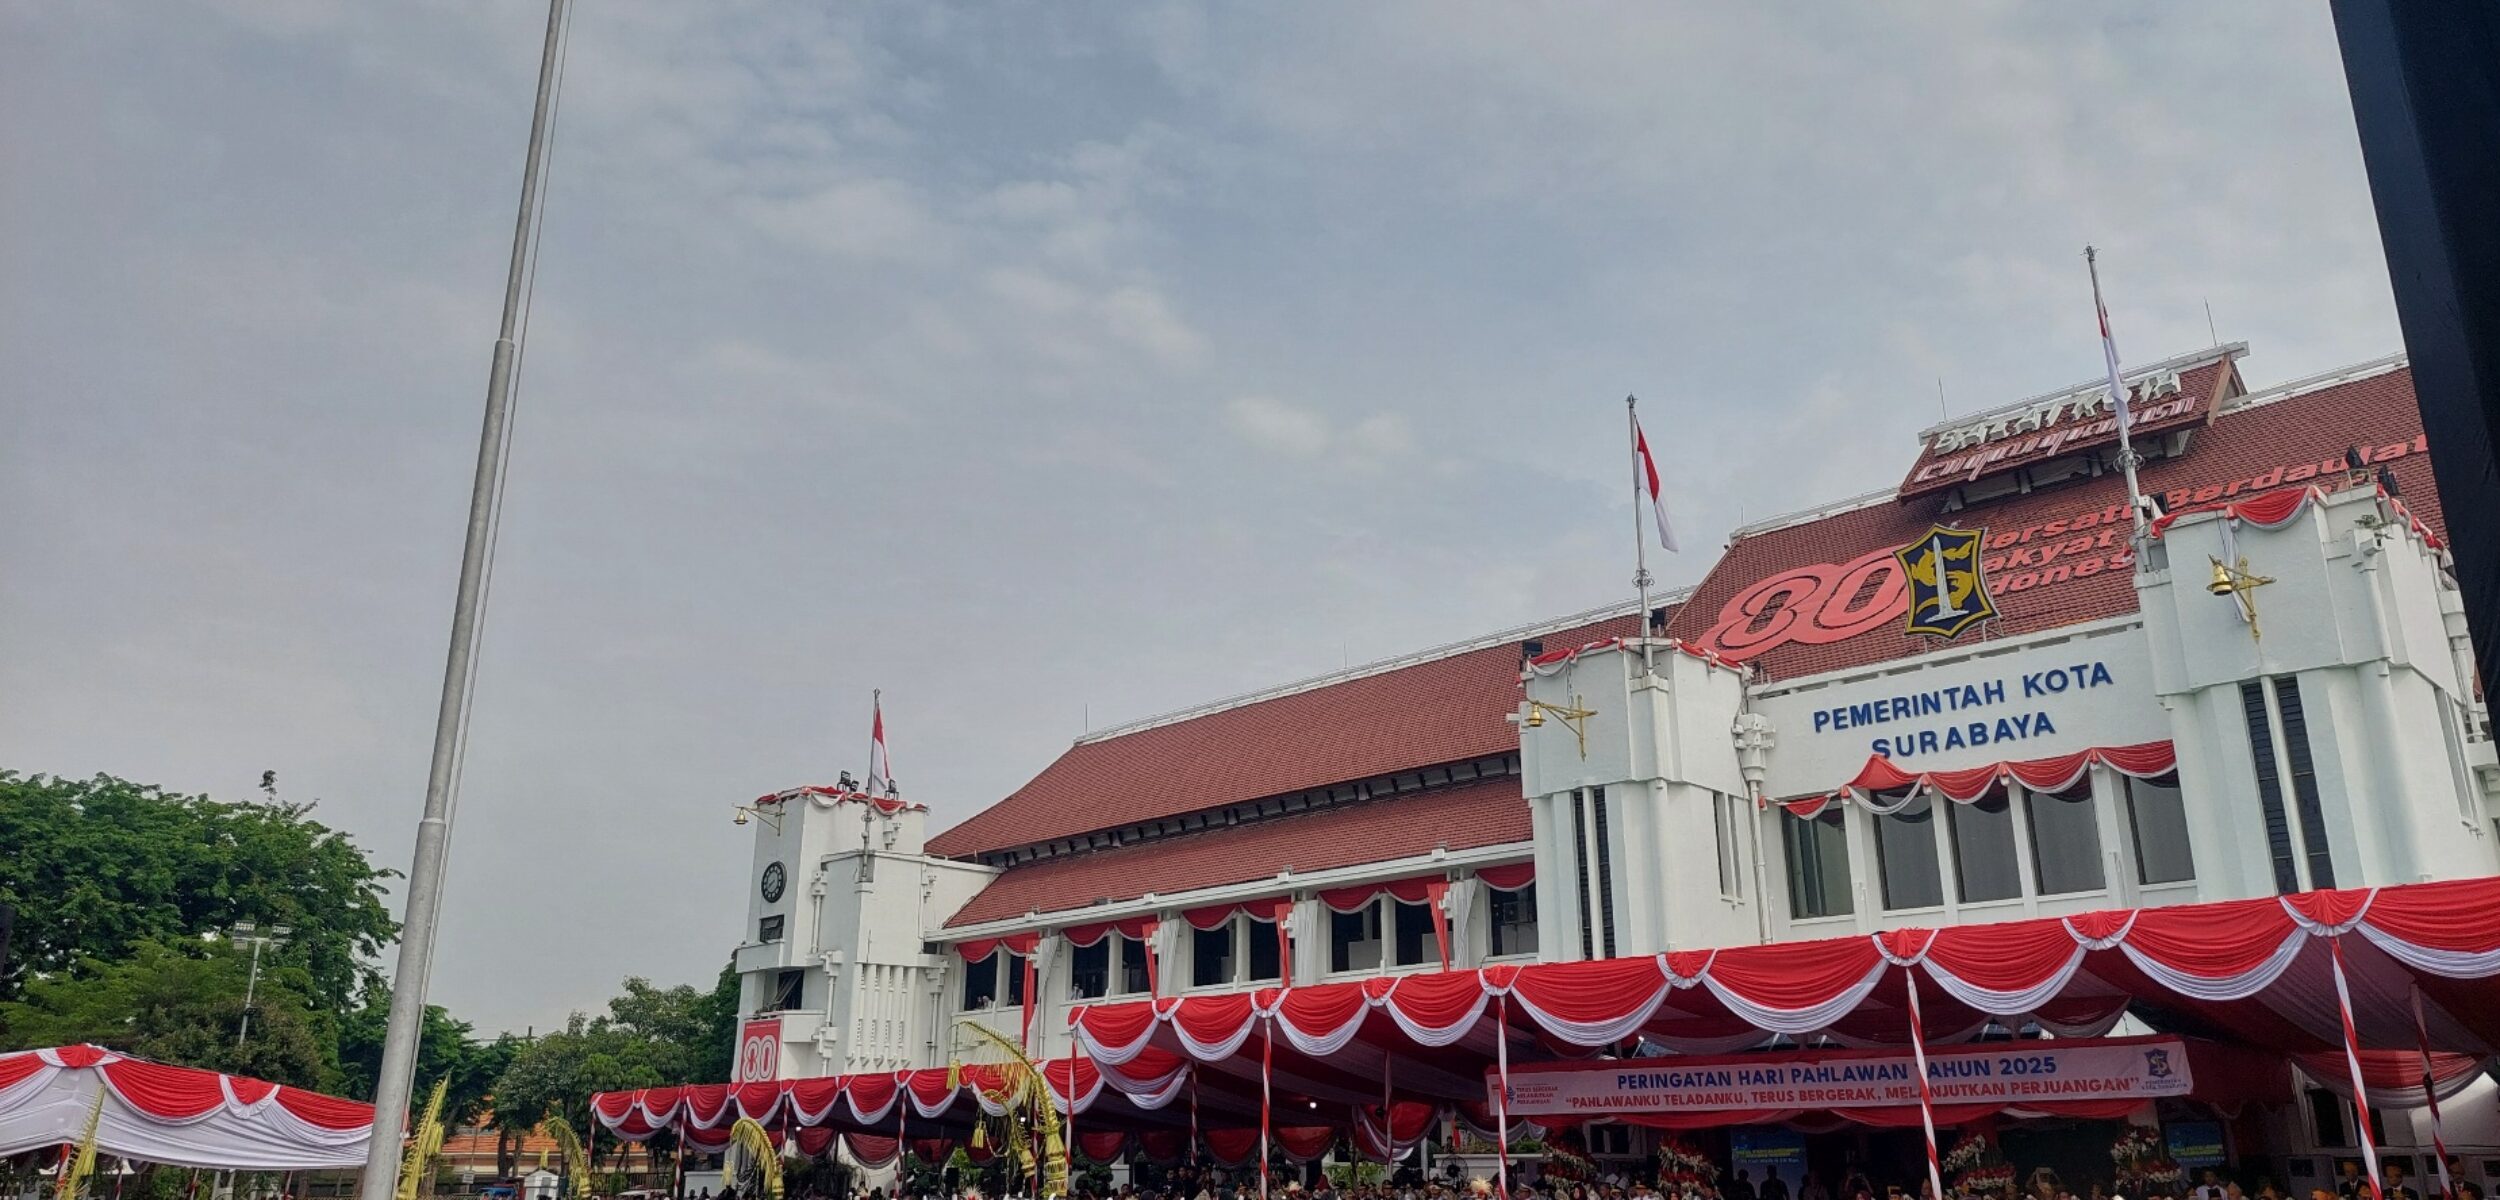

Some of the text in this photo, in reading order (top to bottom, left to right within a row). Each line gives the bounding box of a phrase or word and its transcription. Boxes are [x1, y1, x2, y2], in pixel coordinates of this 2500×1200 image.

[1984, 528, 2117, 573] akyat
[1694, 545, 1909, 662] 80
[1813, 661, 2114, 733] PEMERINTAH KOTA
[1871, 711, 2056, 759] SURABAYA
[742, 1034, 777, 1082] 80
[1617, 1056, 2057, 1090] PERINGATAN HARI PAHLAWAN AHUN 2025
[1663, 1092, 1748, 1106] TELADANKU,
[1751, 1090, 1795, 1103] TERUS
[1801, 1087, 1881, 1101] BERGERAK,
[1885, 1082, 2005, 1100] MELNJUTKAN
